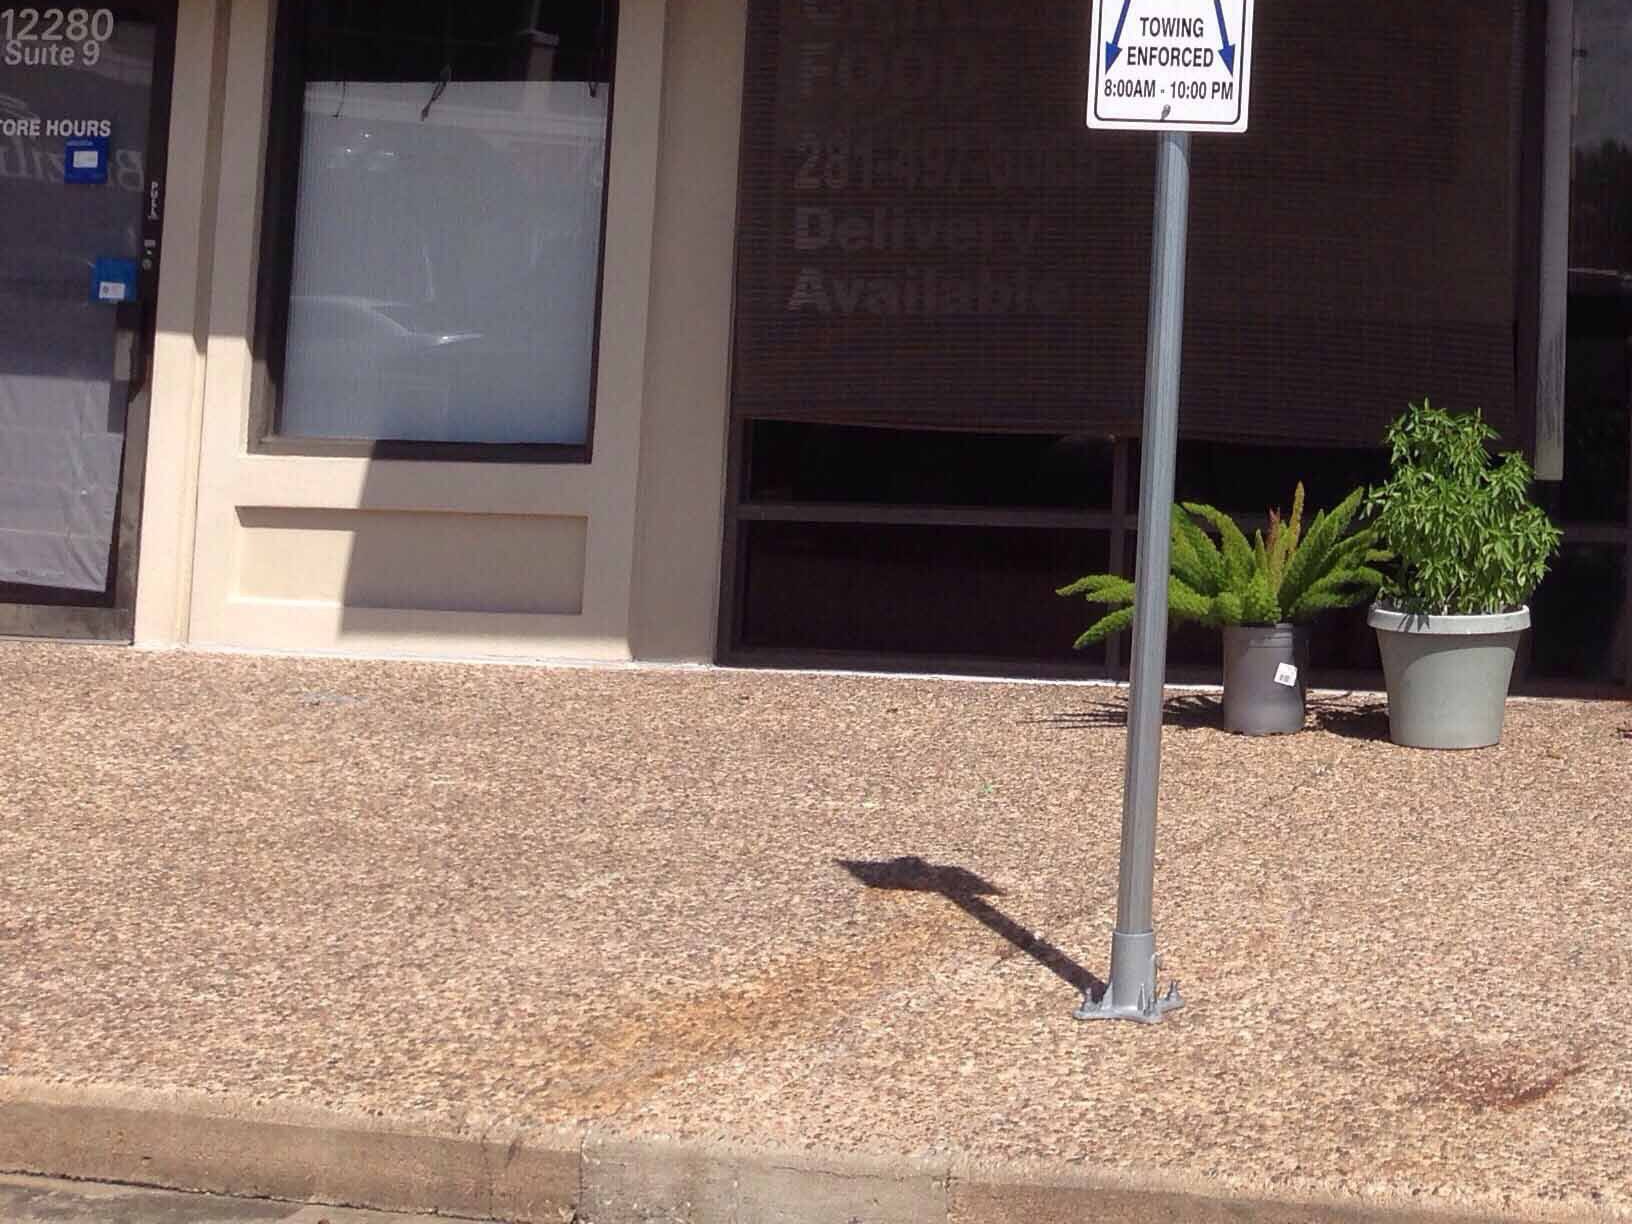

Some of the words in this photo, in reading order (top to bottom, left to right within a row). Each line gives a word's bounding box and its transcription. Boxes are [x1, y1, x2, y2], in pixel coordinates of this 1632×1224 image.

[1, 7, 114, 42] 12280
[1140, 16, 1204, 38] TOWING
[4, 39, 75, 66] Suite
[82, 39, 100, 66] 9
[1127, 46, 1214, 68] ENFORCED
[1103, 78, 1156, 98] 8:00AM
[1170, 80, 1207, 100] 10:00
[1211, 81, 1234, 101] PM
[0, 118, 40, 136] ORE
[46, 118, 111, 137] HOURS
